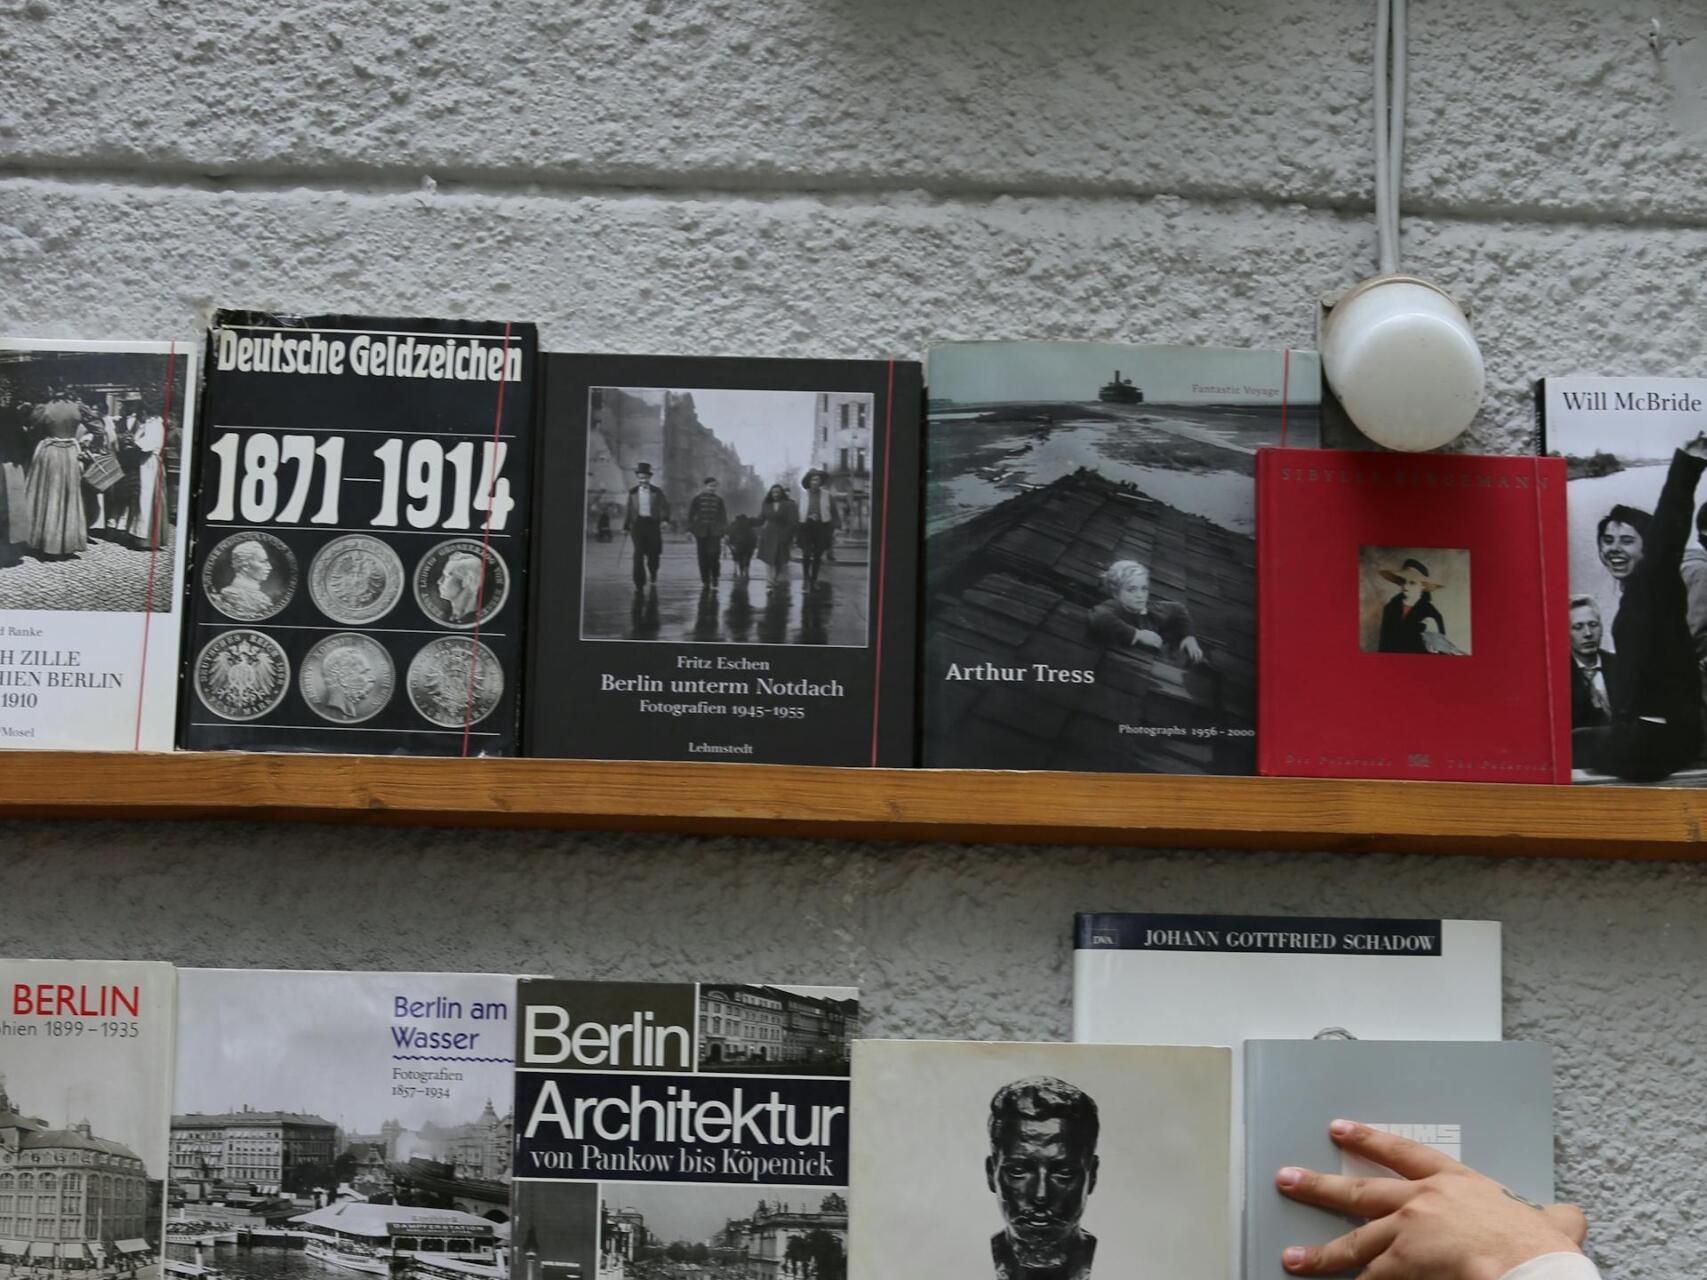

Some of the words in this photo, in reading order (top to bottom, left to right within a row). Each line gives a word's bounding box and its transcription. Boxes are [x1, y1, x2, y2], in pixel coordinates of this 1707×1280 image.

[217, 330, 344, 376] Deutsche
[349, 334, 523, 382] Geldzeichen
[1192, 384, 1239, 396] Fantastic
[1244, 385, 1280, 398] Voyage
[1563, 391, 1607, 411] Will
[1615, 392, 1702, 412] McBride
[8, 627, 44, 637] Ranke
[20, 650, 81, 667] ZILLE
[677, 656, 712, 670] Fritz
[717, 657, 770, 671] Eschen
[48, 672, 124, 689] BERLIN
[943, 663, 1027, 683] Arthur
[1033, 664, 1095, 684] Tress
[601, 674, 664, 693] Berlin
[671, 679, 749, 695] unterm
[756, 677, 844, 697] Notdach
[640, 699, 727, 718] Fotografien
[1119, 723, 1186, 738] Photographs
[689, 742, 753, 756] Lehmstedt
[1144, 928, 1220, 948] JOHANN
[1226, 931, 1338, 951] GOTTFRIED
[1343, 934, 1435, 952] SCHADOW
[14, 984, 139, 1016] BERLIN
[394, 996, 463, 1020] Berlin
[470, 1002, 508, 1021] am
[45, 1021, 84, 1037] 1899
[101, 1022, 140, 1038] 1935
[391, 1026, 480, 1051] Wasser
[523, 1005, 690, 1068] Berlin
[392, 1067, 464, 1083] Fotografien
[523, 1080, 845, 1147] Architektur
[530, 1150, 574, 1170] von
[581, 1145, 674, 1173] Pankow
[680, 1147, 716, 1175] bis
[722, 1148, 833, 1182] Köpenick
